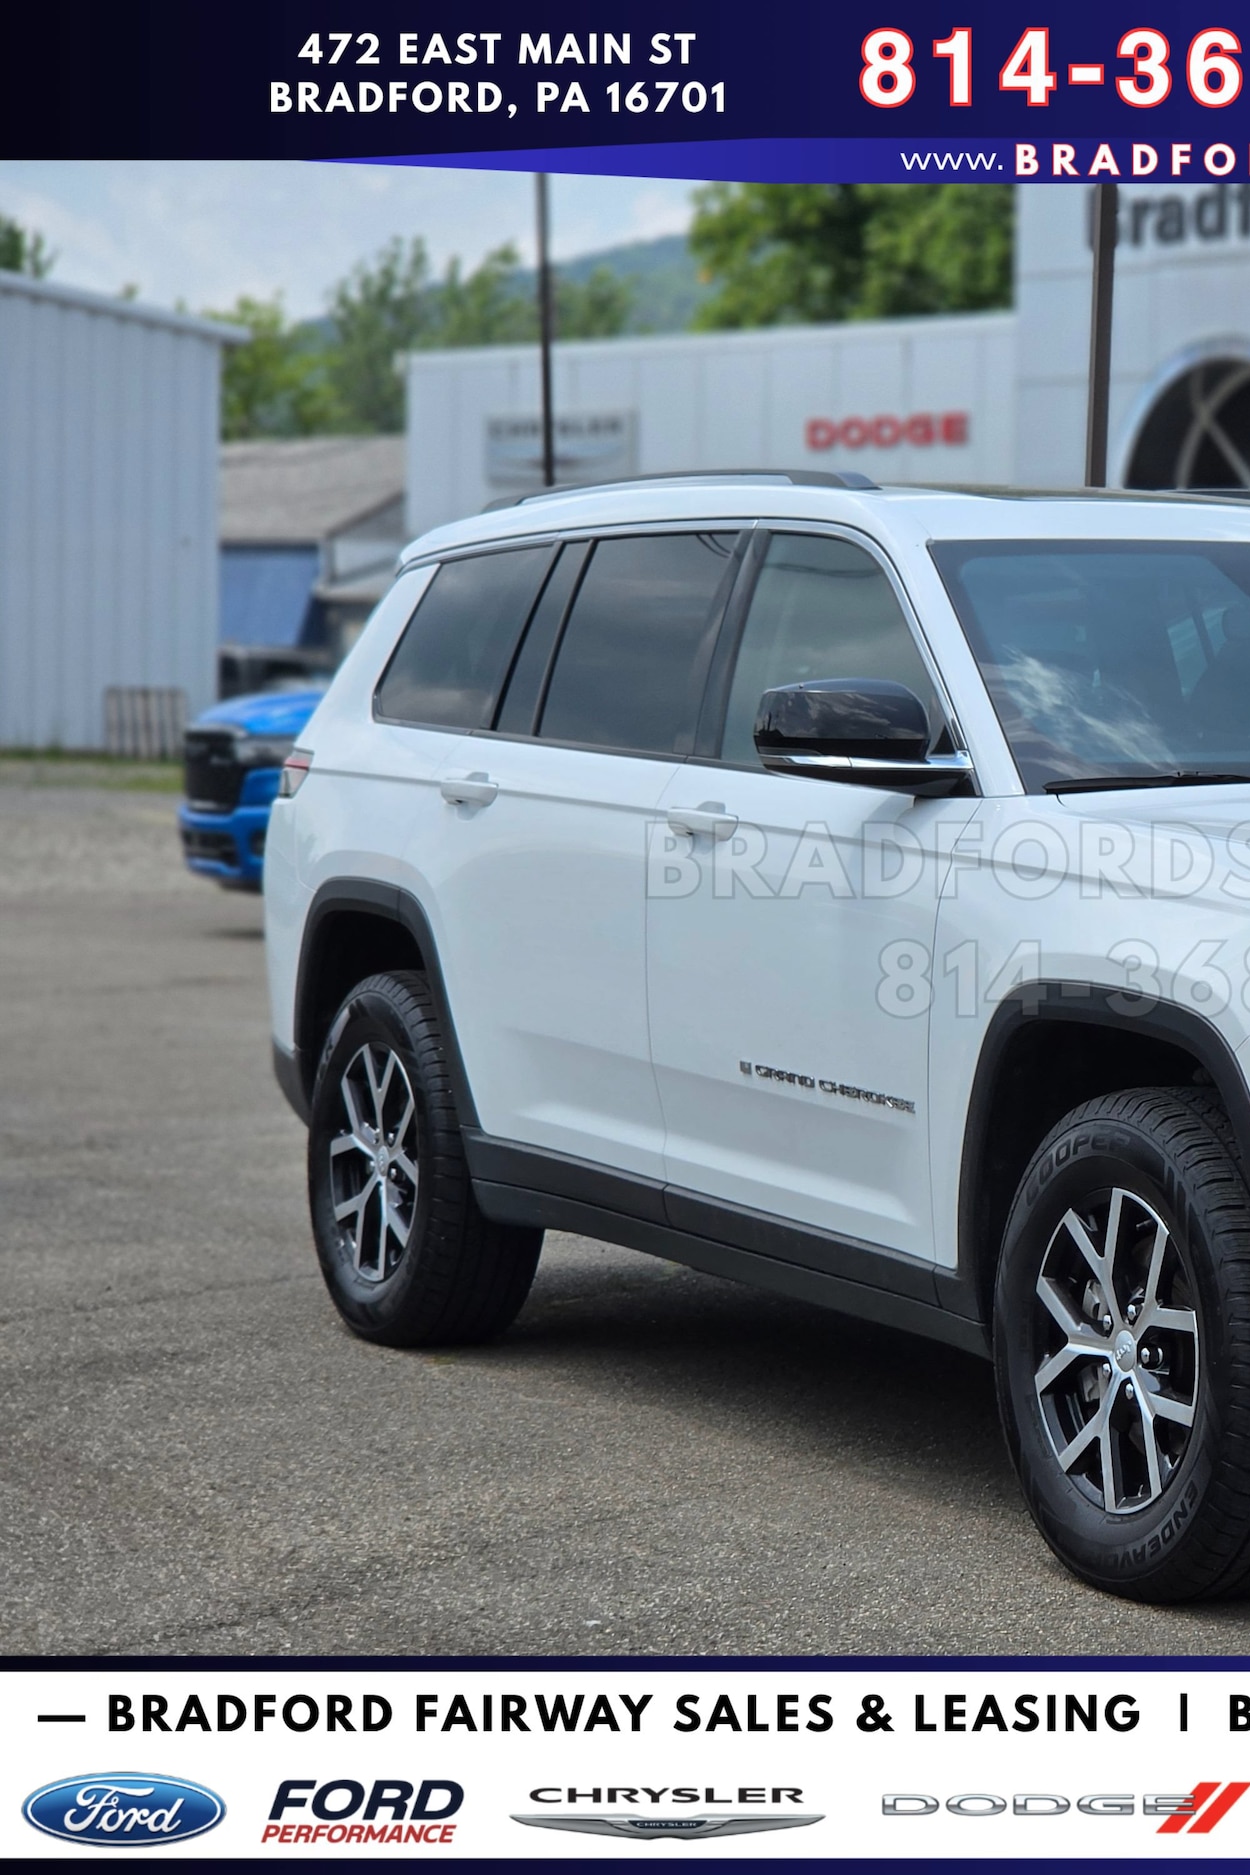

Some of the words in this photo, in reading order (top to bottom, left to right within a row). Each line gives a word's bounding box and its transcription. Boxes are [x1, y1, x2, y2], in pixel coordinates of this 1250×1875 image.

[805, 412, 970, 451] DODGE
[755, 1064, 816, 1089] GRAND
[818, 1079, 916, 1114] CHEROKEE
